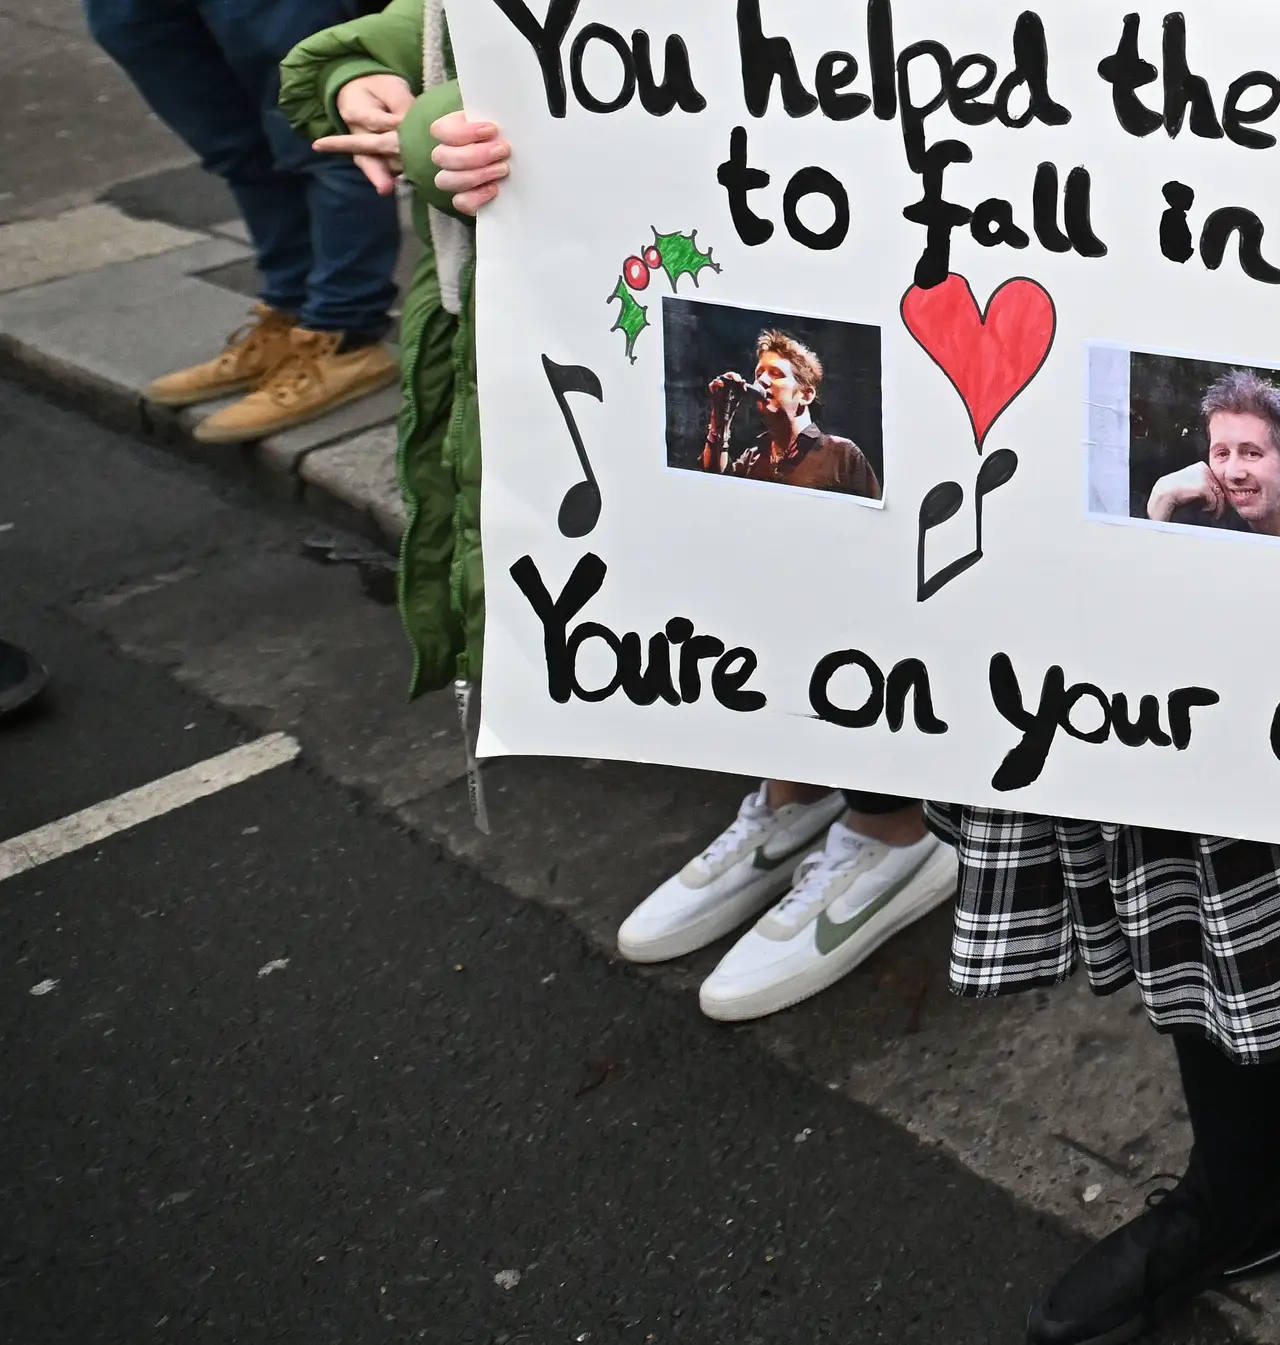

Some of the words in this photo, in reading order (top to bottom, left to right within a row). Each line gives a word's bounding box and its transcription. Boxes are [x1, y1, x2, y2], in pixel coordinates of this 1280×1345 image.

[716, 125, 850, 251] to
[902, 139, 1108, 289] fall
[808, 648, 949, 735] on
[988, 652, 1220, 792] your
